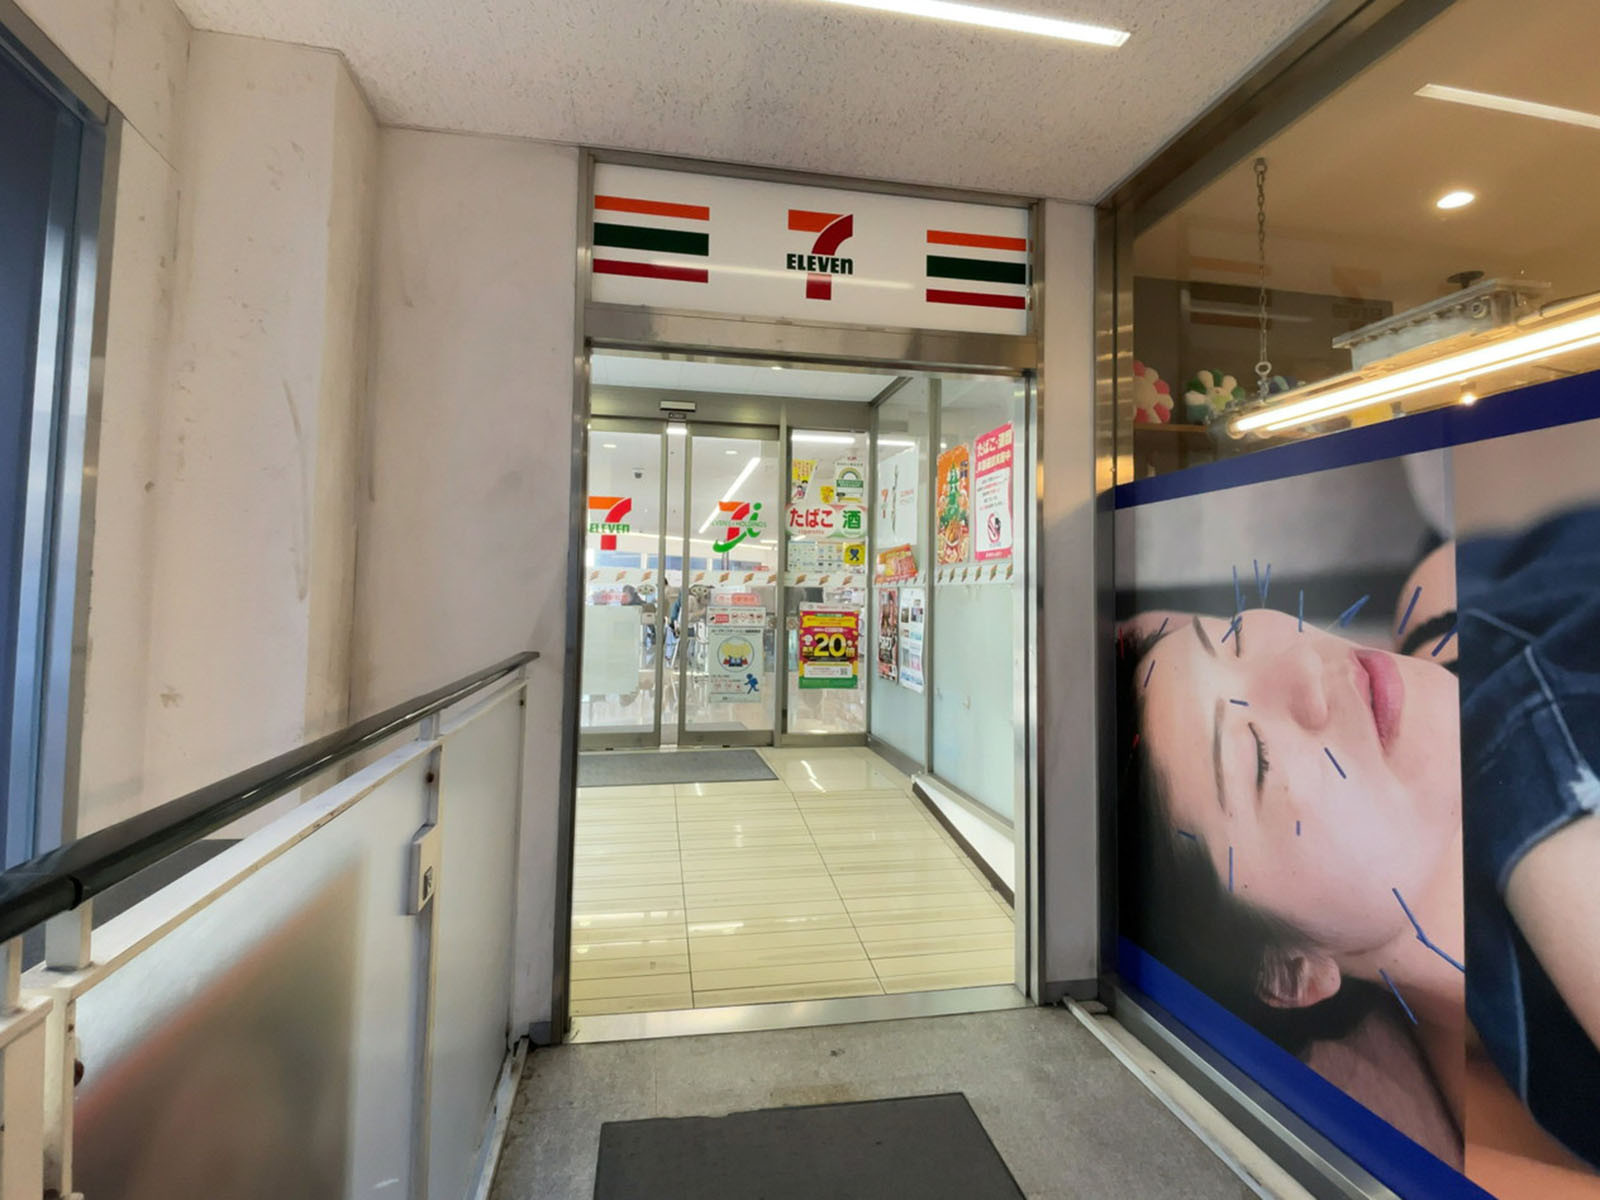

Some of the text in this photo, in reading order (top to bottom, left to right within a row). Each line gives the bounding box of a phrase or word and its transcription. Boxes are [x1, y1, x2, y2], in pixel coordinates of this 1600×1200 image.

[790, 508, 833, 528] たばこ
[842, 510, 862, 529] 酒
